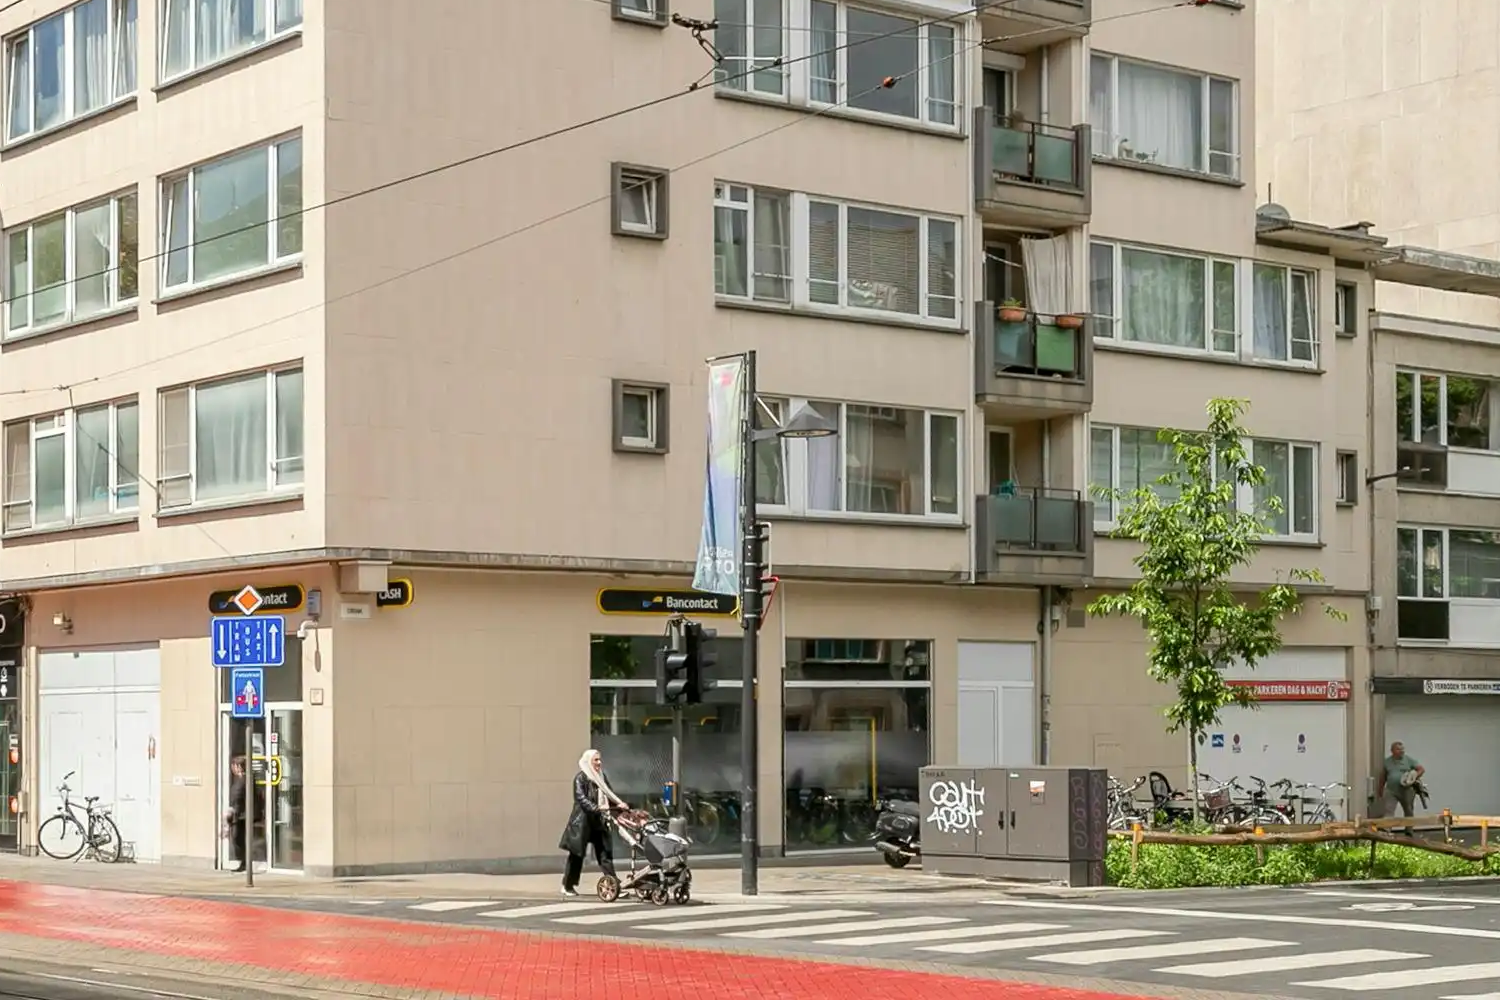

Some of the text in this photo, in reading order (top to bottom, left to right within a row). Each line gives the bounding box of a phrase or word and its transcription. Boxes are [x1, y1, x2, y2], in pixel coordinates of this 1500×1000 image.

[378, 587, 402, 600] CASH
[666, 596, 719, 609] Bancontact
[1287, 684, 1300, 694] DAG
[1306, 684, 1327, 694] NACHT
